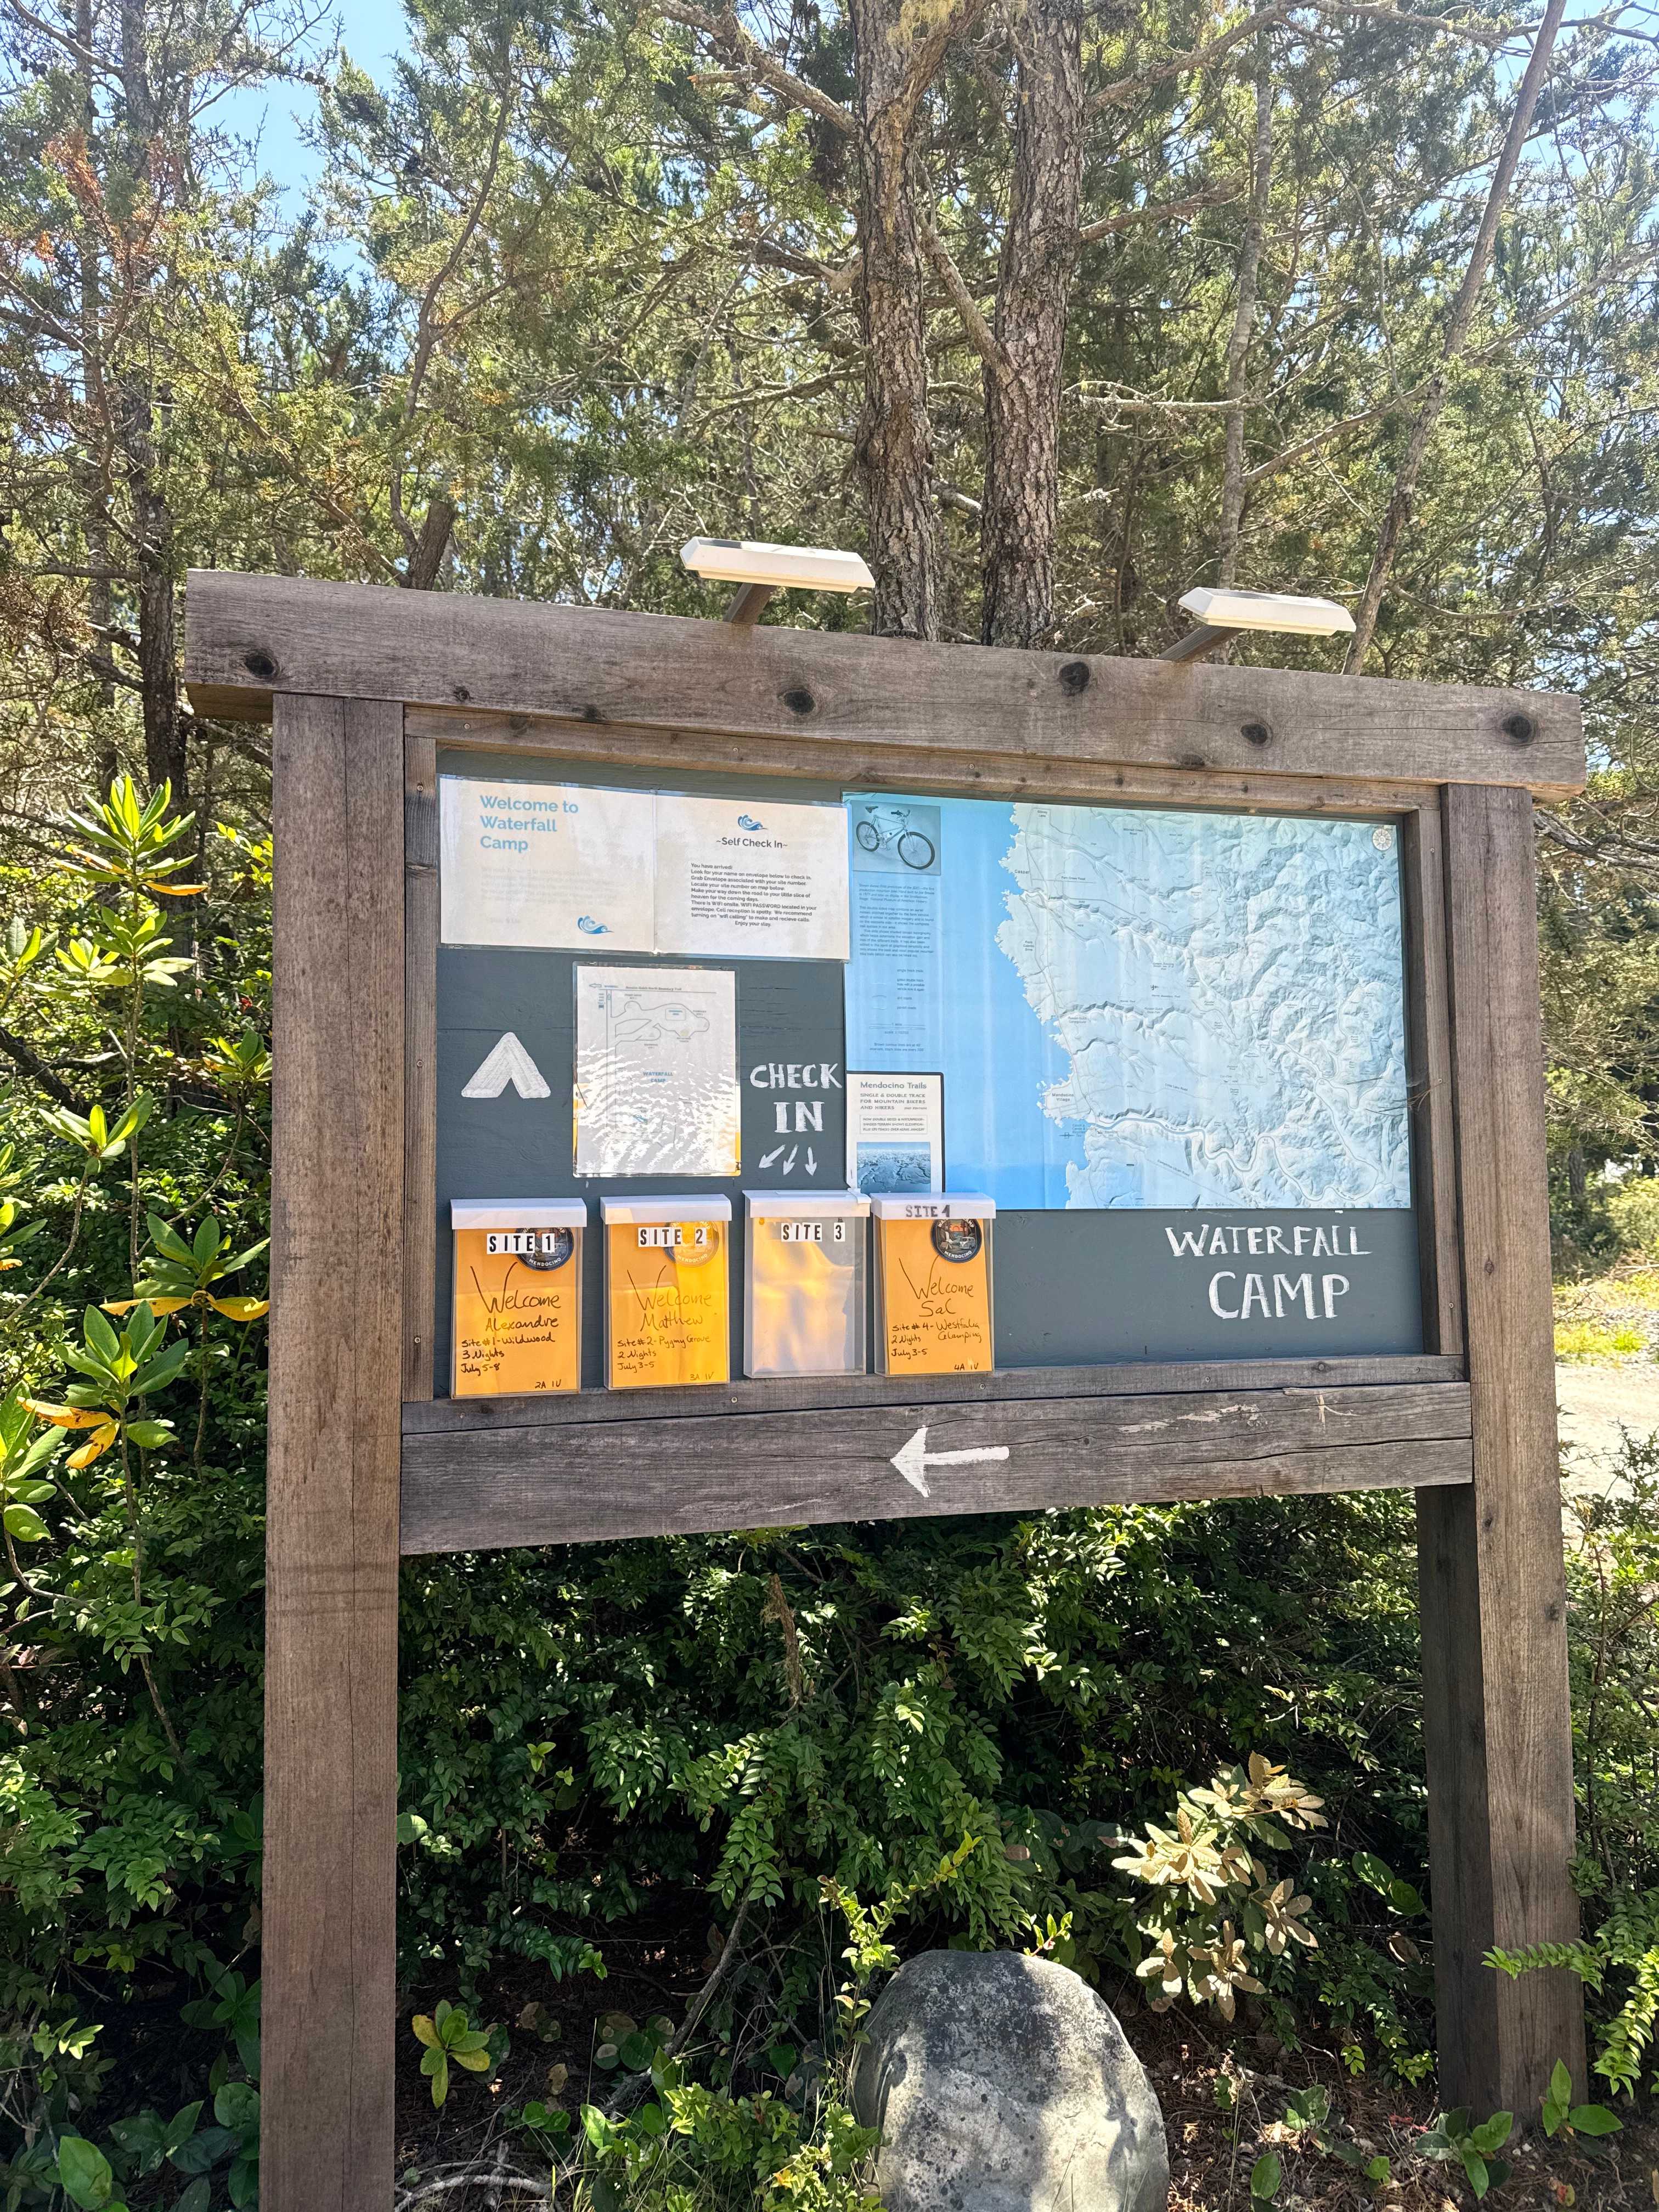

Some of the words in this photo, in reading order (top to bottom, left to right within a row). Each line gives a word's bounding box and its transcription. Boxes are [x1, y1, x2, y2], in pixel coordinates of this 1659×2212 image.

[480, 795, 558, 812] Welcome
[563, 800, 579, 813] to
[480, 816, 557, 832] Waterfall
[480, 836, 528, 853] Camp
[742, 838, 771, 848] Check
[750, 1063, 842, 1088] CHECK
[773, 1101, 825, 1133] IN
[906, 1205, 938, 1217] SITE
[941, 1204, 950, 1217] 4
[640, 1228, 681, 1245] SITE
[696, 1228, 703, 1244] 2
[783, 1224, 821, 1240] SITE
[836, 1224, 842, 1240] 3
[1165, 1224, 1372, 1256] WATERFALL
[489, 1235, 533, 1252] SITE
[545, 1235, 551, 1250] 1
[528, 1257, 561, 1266] MENDOCINO
[676, 1254, 708, 1262] MENDOCINO
[899, 1255, 974, 1299] Welcome
[470, 1262, 561, 1313] Welcome
[627, 1265, 712, 1310] Welcome
[1209, 1271, 1350, 1319] CAMP
[919, 1298, 956, 1317] Sal
[485, 1314, 559, 1331] Alexandre
[640, 1311, 703, 1331] Matthew
[686, 1334, 711, 1343] Grove
[891, 1335, 898, 1344] 2
[899, 1334, 921, 1345] Nights
[462, 1350, 470, 1359] 3
[472, 1347, 505, 1361] Nights
[627, 1348, 657, 1359] Nights
[891, 1348, 911, 1360] July
[912, 1348, 928, 1356] 3-5
[460, 1363, 481, 1376] July
[482, 1362, 500, 1372] 5-8
[617, 1362, 637, 1373] July
[954, 1363, 965, 1371] 4A
[534, 1381, 546, 1389] 2A
